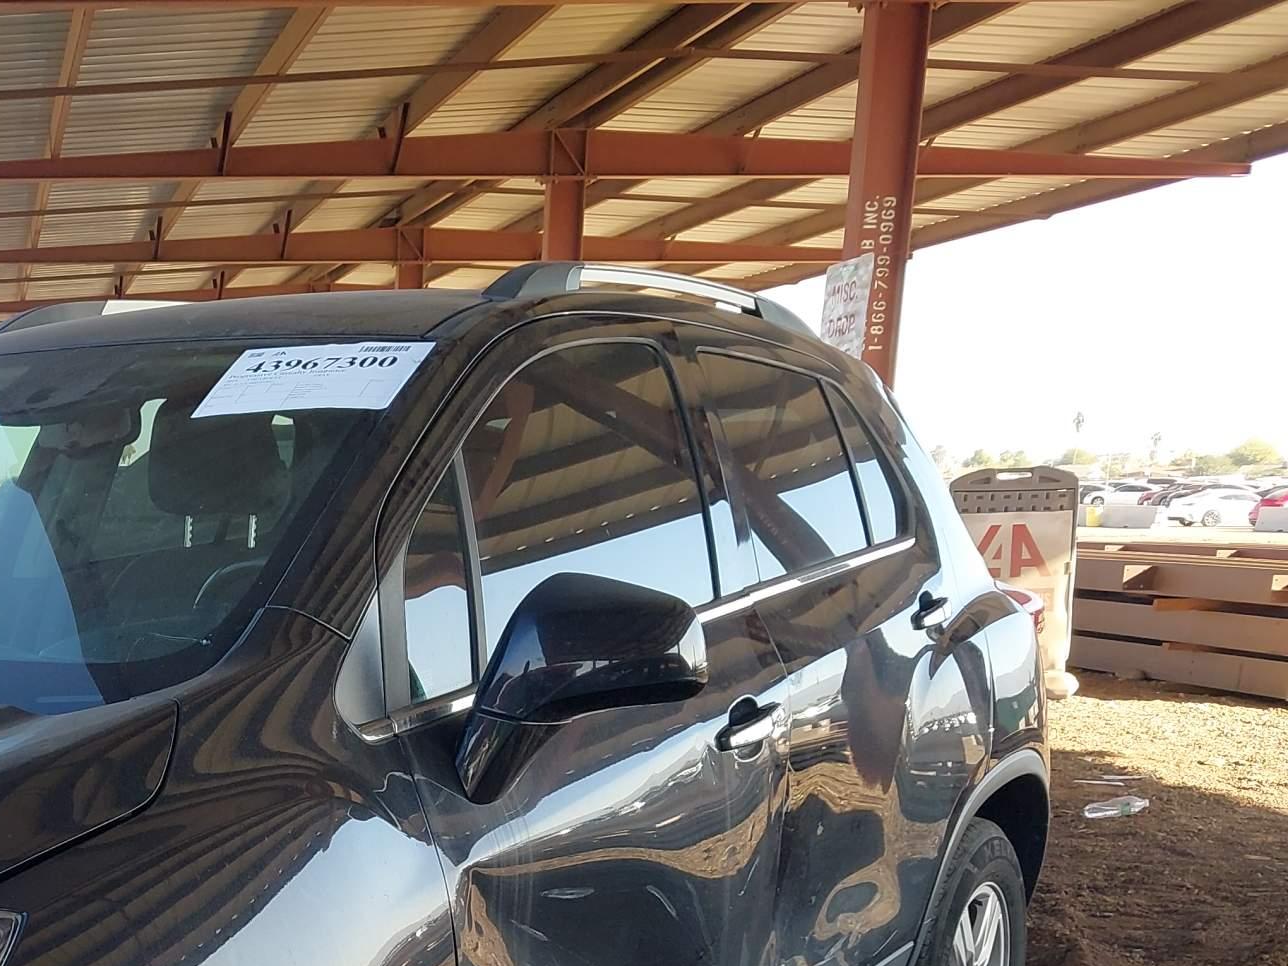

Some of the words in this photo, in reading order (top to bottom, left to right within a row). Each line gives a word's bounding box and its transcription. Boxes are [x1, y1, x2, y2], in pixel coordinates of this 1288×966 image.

[863, 195, 880, 229] INC.
[868, 196, 897, 351] 1-866-799-0969
[827, 314, 856, 337] DROP
[245, 354, 399, 374] 43967300
